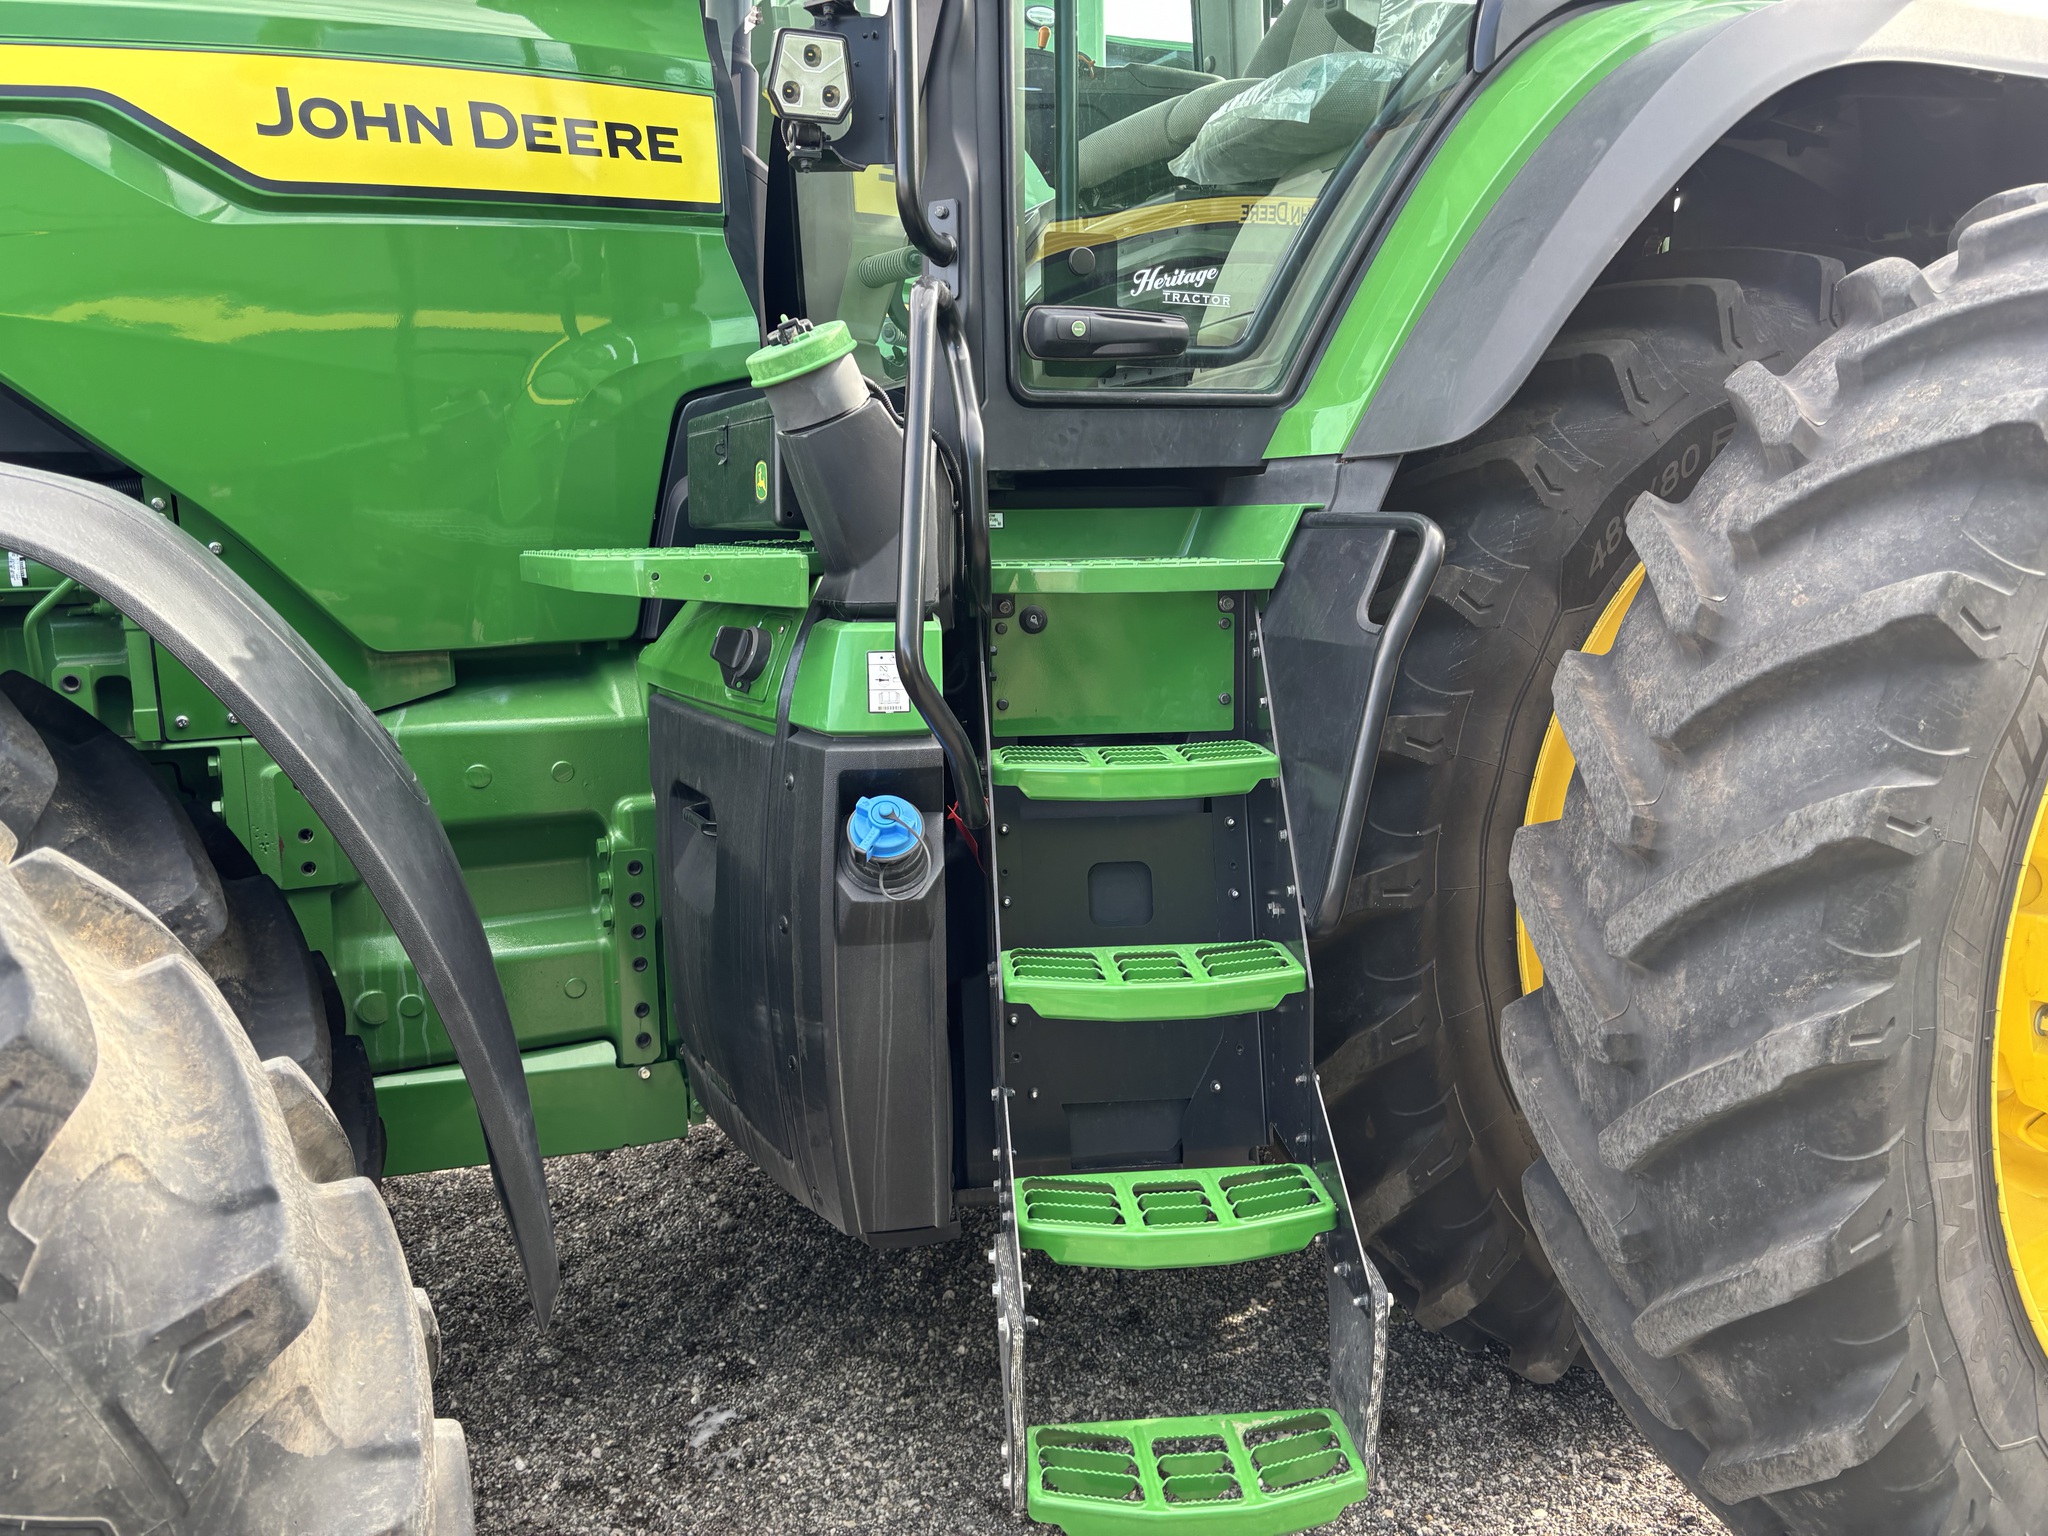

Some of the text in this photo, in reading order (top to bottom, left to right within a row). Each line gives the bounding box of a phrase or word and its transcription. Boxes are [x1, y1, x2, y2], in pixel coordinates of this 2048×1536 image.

[257, 87, 683, 163] JOHN DEERE
[1131, 265, 1218, 297] Heritage
[1163, 292, 1230, 305] TRACTOR
